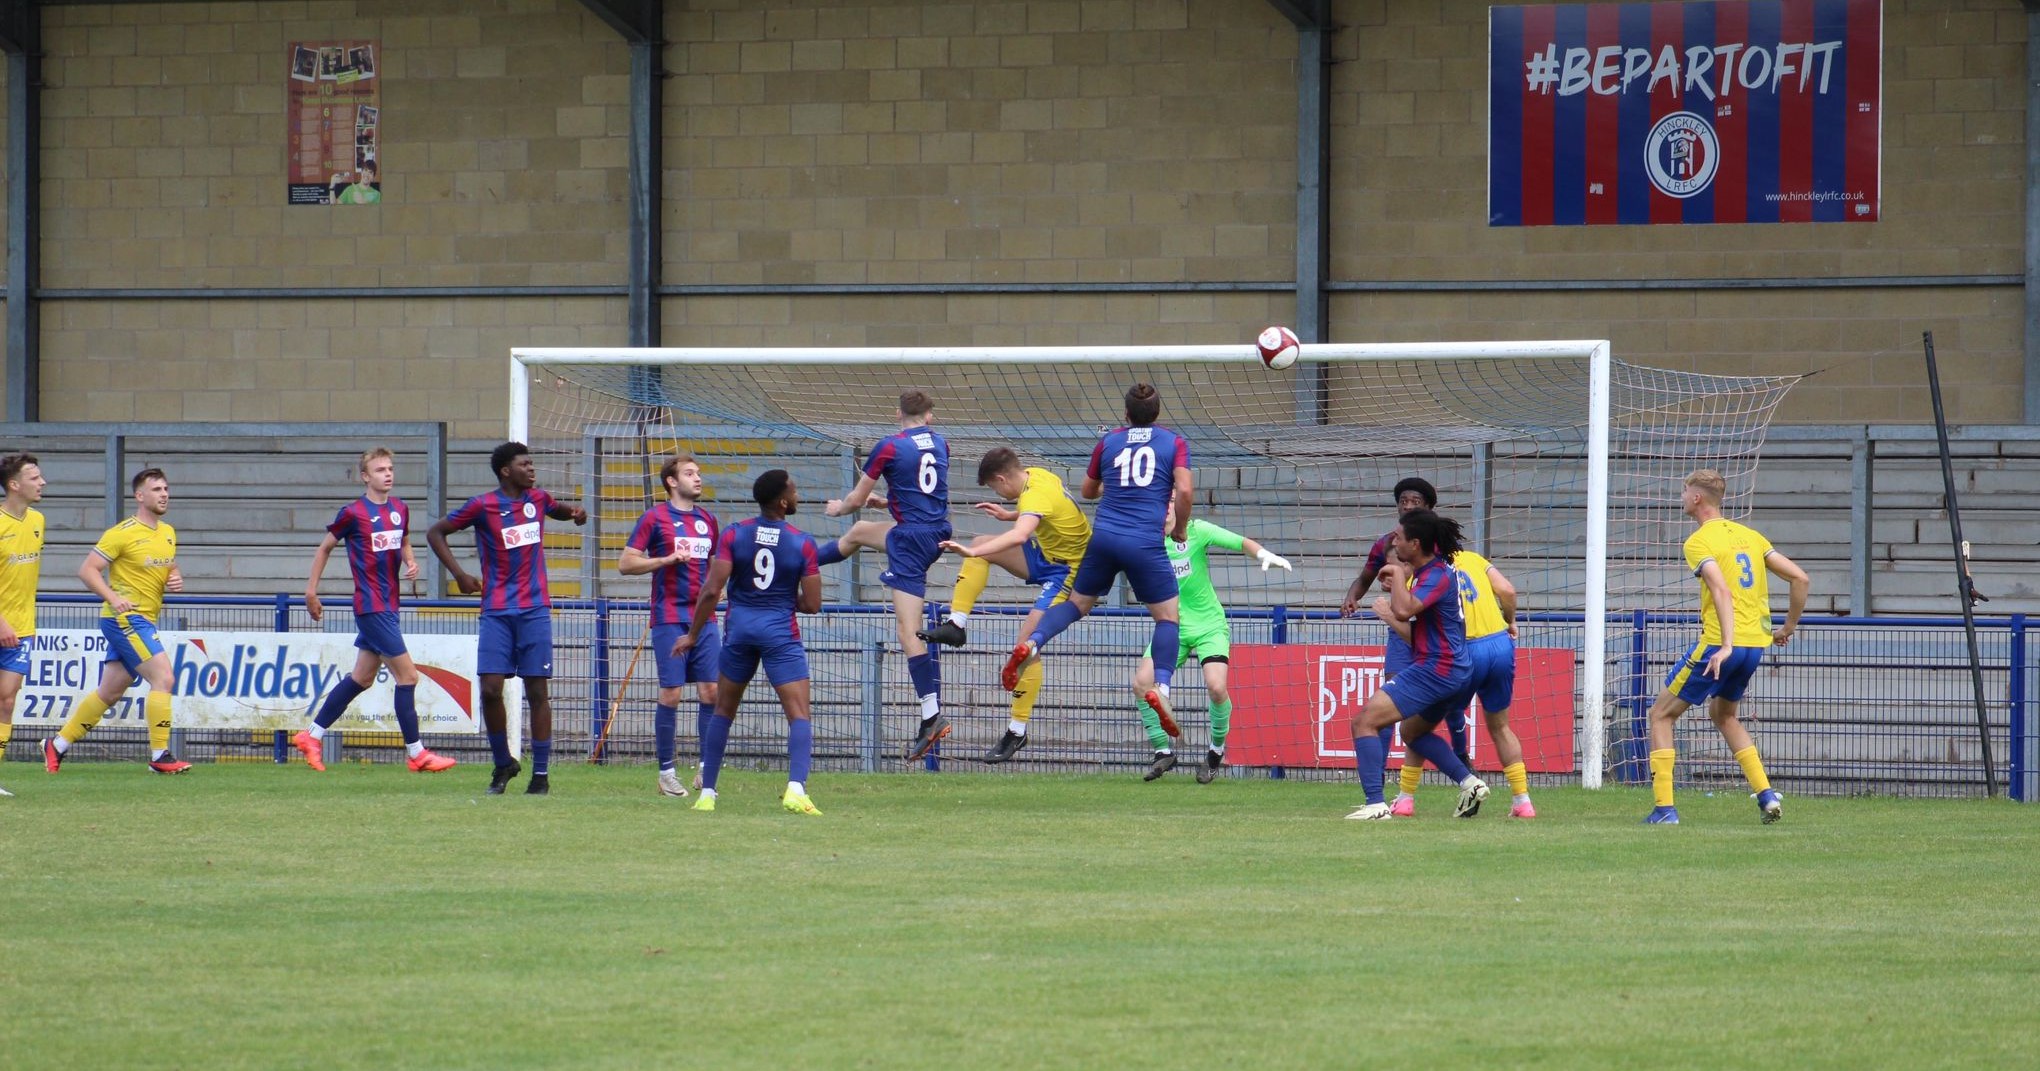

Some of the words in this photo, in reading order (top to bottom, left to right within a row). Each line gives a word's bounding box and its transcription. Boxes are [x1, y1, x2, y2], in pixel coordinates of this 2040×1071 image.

[1526, 41, 1843, 101] #BEPARTOFIT
[321, 83, 332, 95] 10
[1657, 118, 1707, 139] HINCKLEY
[1666, 179, 1698, 192] LRFC
[1765, 191, 1864, 203] www.hinckleylrfc.co.uk
[918, 452, 937, 494] 6
[1113, 446, 1156, 487] 10
[753, 547, 775, 590] 9
[1736, 553, 1754, 588] 3
[172, 643, 337, 717] holiday
[23, 694, 73, 719] 277
[356, 714, 370, 723] you
[422, 713, 431, 721] of
[432, 713, 458, 722] choice
